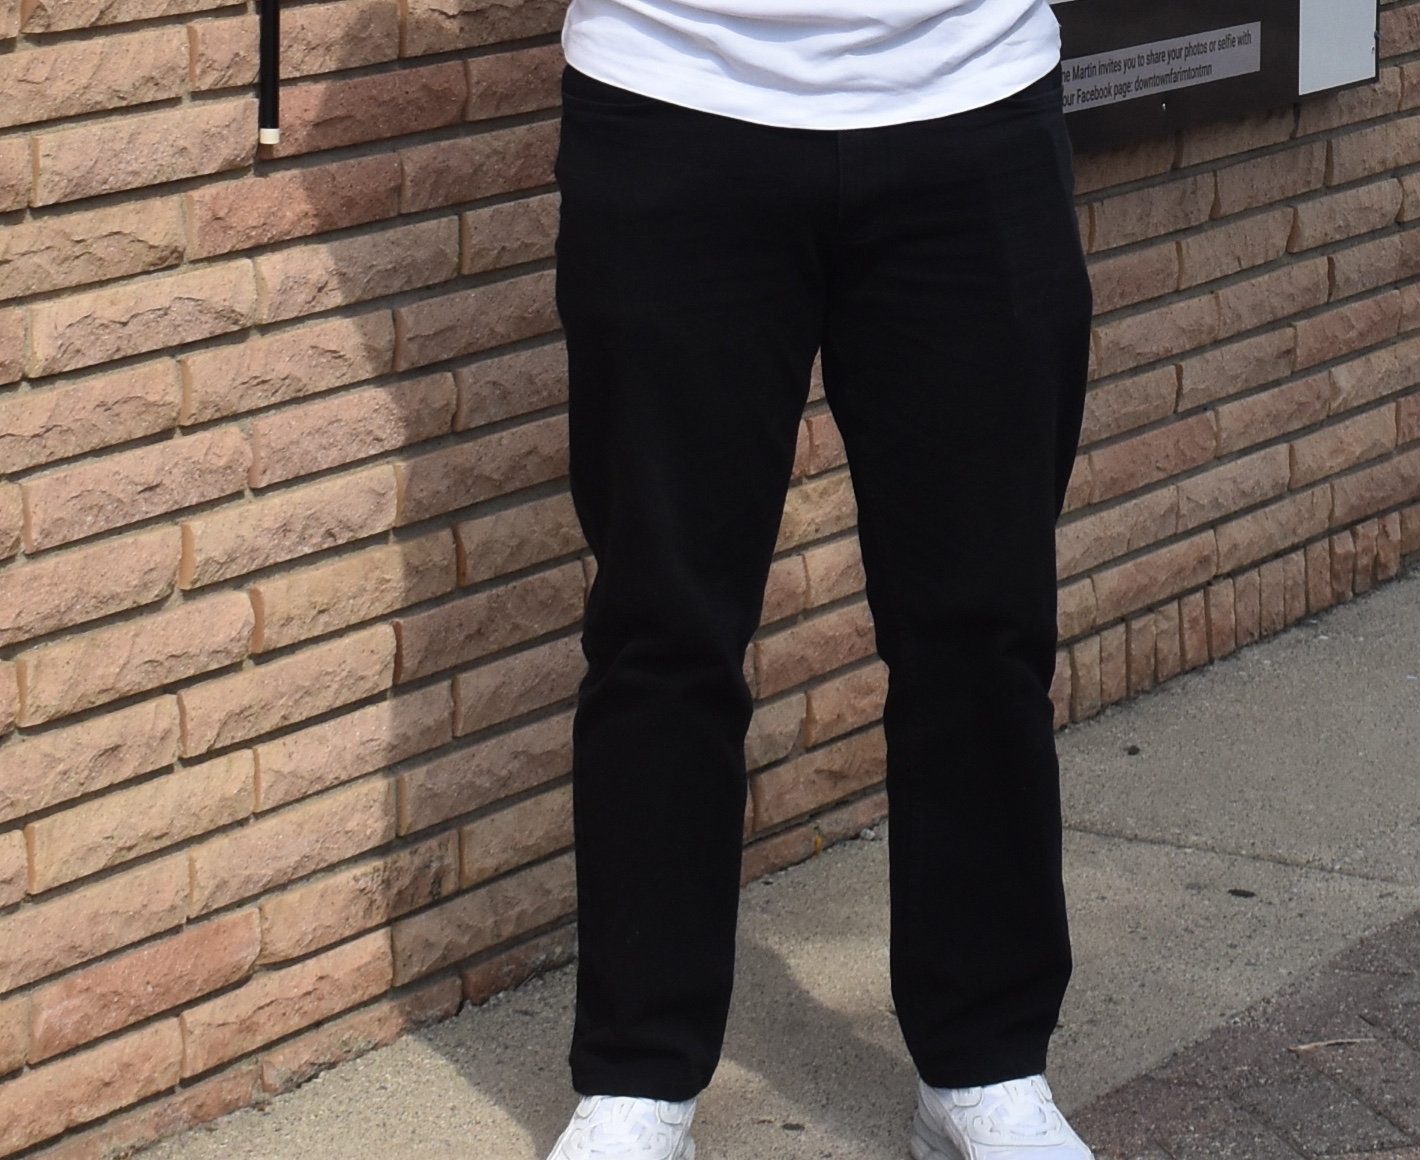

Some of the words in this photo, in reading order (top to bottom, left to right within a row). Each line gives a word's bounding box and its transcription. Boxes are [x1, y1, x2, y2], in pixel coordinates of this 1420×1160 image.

[1072, 62, 1097, 81] Martin
[1099, 58, 1122, 76] invites
[1123, 57, 1137, 75] you
[1137, 53, 1146, 68] to
[1146, 49, 1166, 66] share
[1166, 46, 1184, 65] your
[1184, 41, 1208, 61] photos
[1209, 40, 1217, 53] or
[1217, 33, 1236, 51] selfie
[1237, 29, 1252, 46] with
[1076, 81, 1113, 104] Facebook
[1113, 81, 1134, 100] page:
